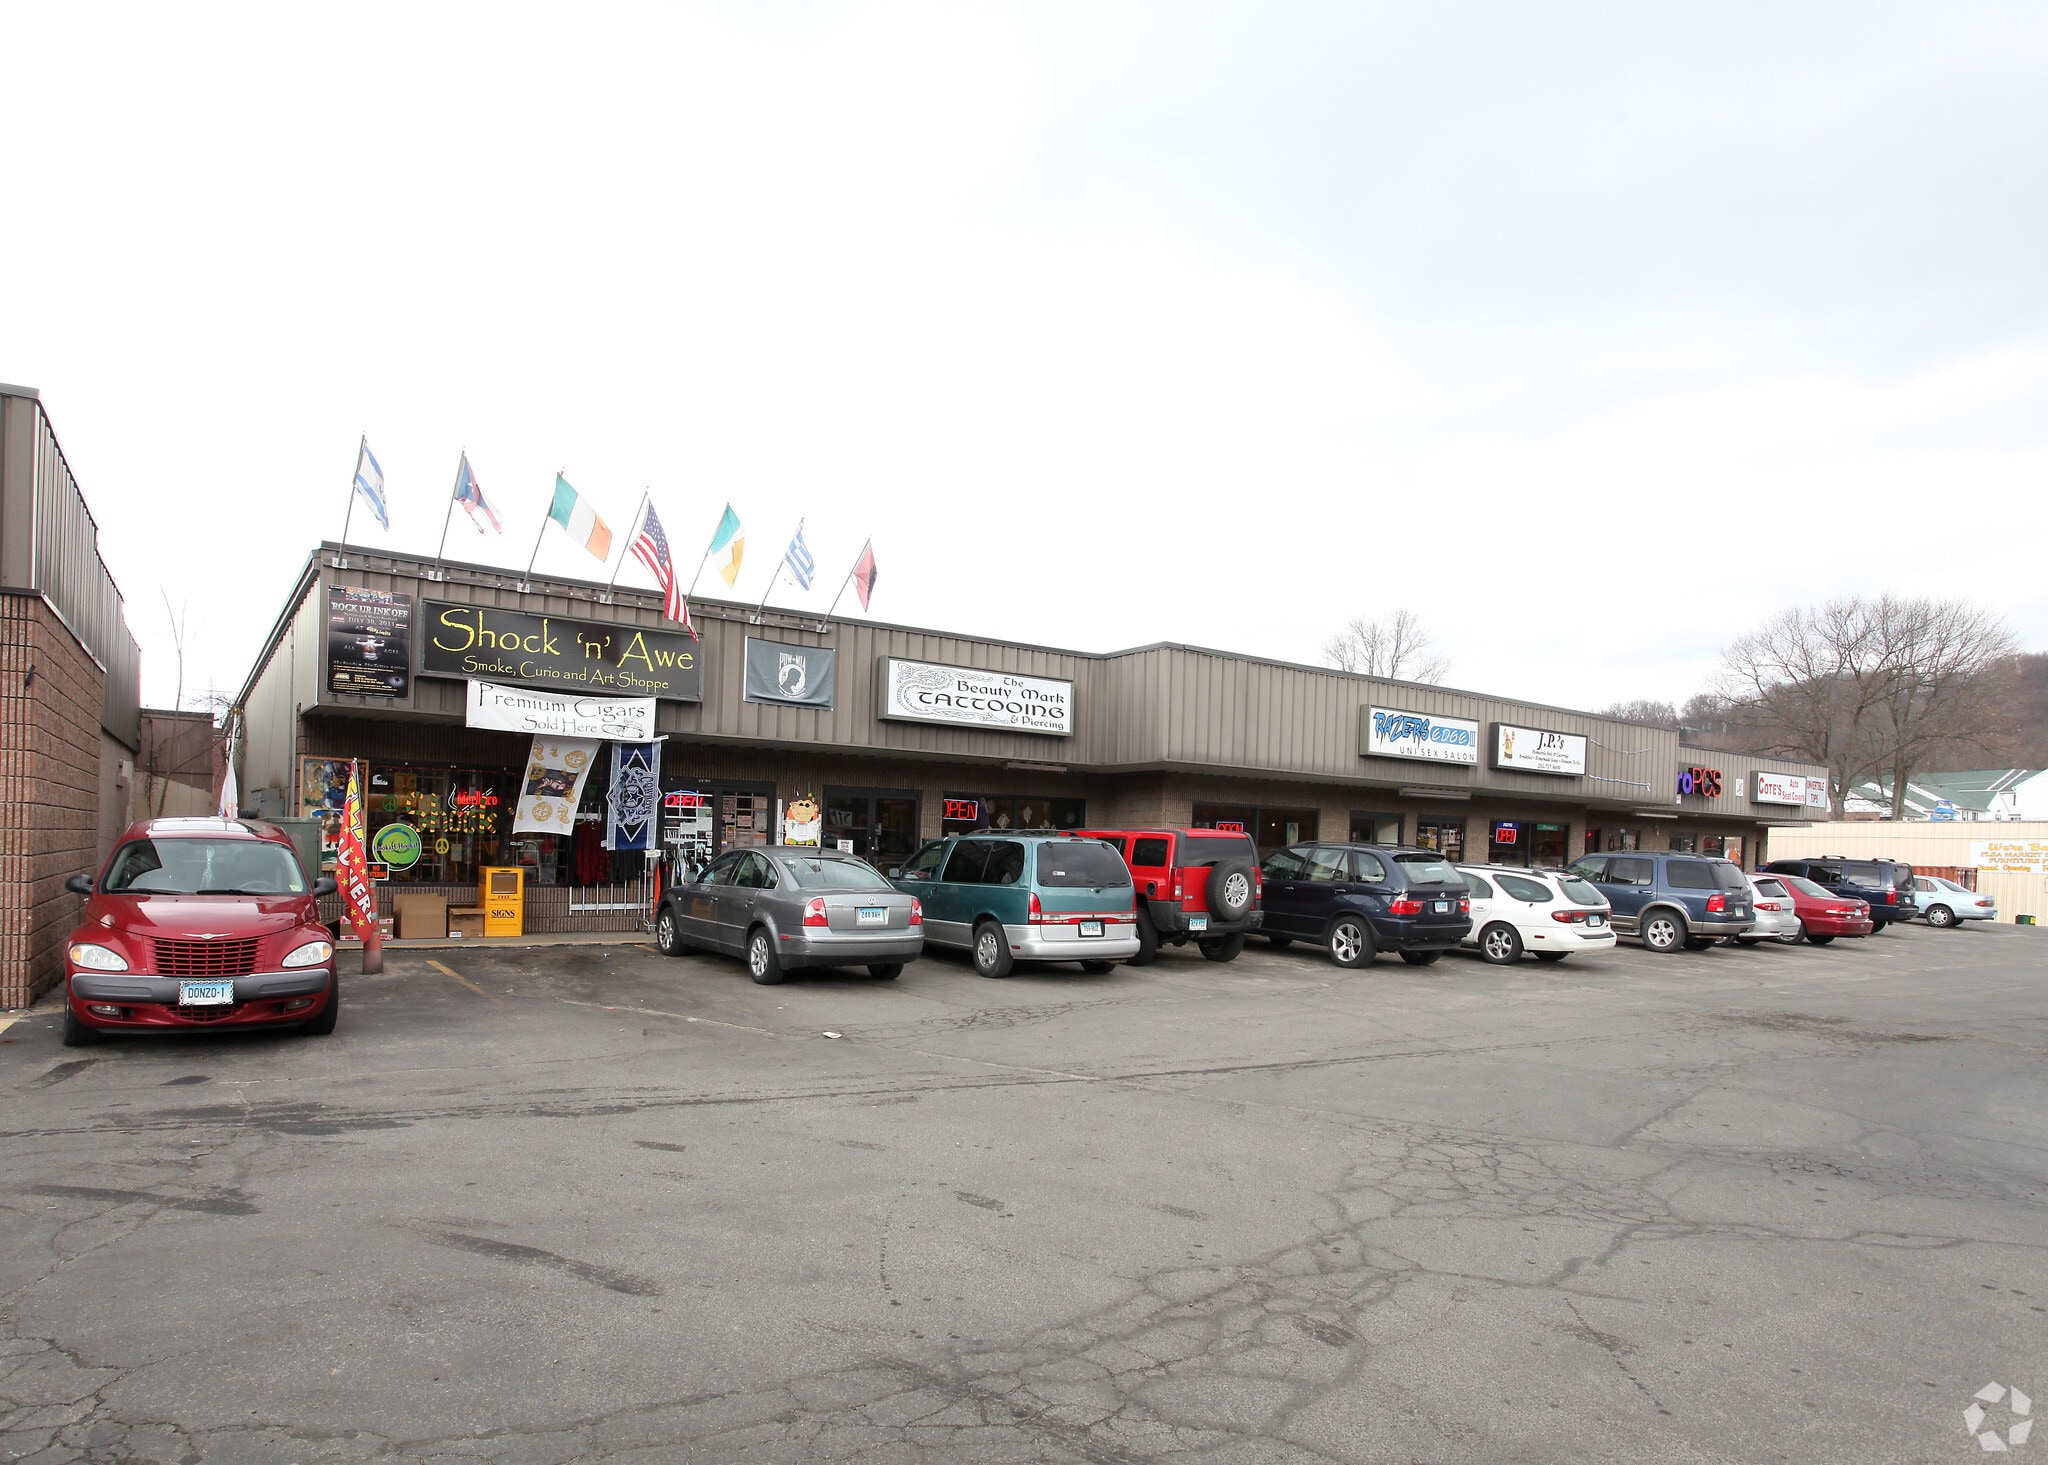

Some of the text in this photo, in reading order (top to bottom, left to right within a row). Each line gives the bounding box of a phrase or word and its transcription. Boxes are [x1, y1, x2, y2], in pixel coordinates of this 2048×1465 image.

[331, 601, 409, 618] ROCK UR INK OFF
[432, 608, 560, 657] Shock
[616, 631, 695, 672] Awe
[461, 655, 669, 693] Smoke, Curio and Art Shoppe
[1003, 677, 1024, 688] The
[957, 680, 1065, 704] Beauty Mark
[478, 682, 645, 723] Premium Cigars
[917, 691, 1065, 719] TATTOOING
[521, 715, 598, 734] Sold Here
[1010, 715, 1064, 730] & Piercing
[1373, 712, 1430, 744] RAZERS
[1537, 732, 1565, 750] J.P.'s
[1444, 750, 1475, 760] SALON
[1789, 778, 1799, 788] Auto
[1806, 781, 1825, 791] ONVERTIBLE
[664, 794, 705, 807] OPEN
[1782, 791, 1805, 802] Seat Covers
[1810, 793, 1819, 803] TOPS
[491, 909, 515, 917] SIGNS
